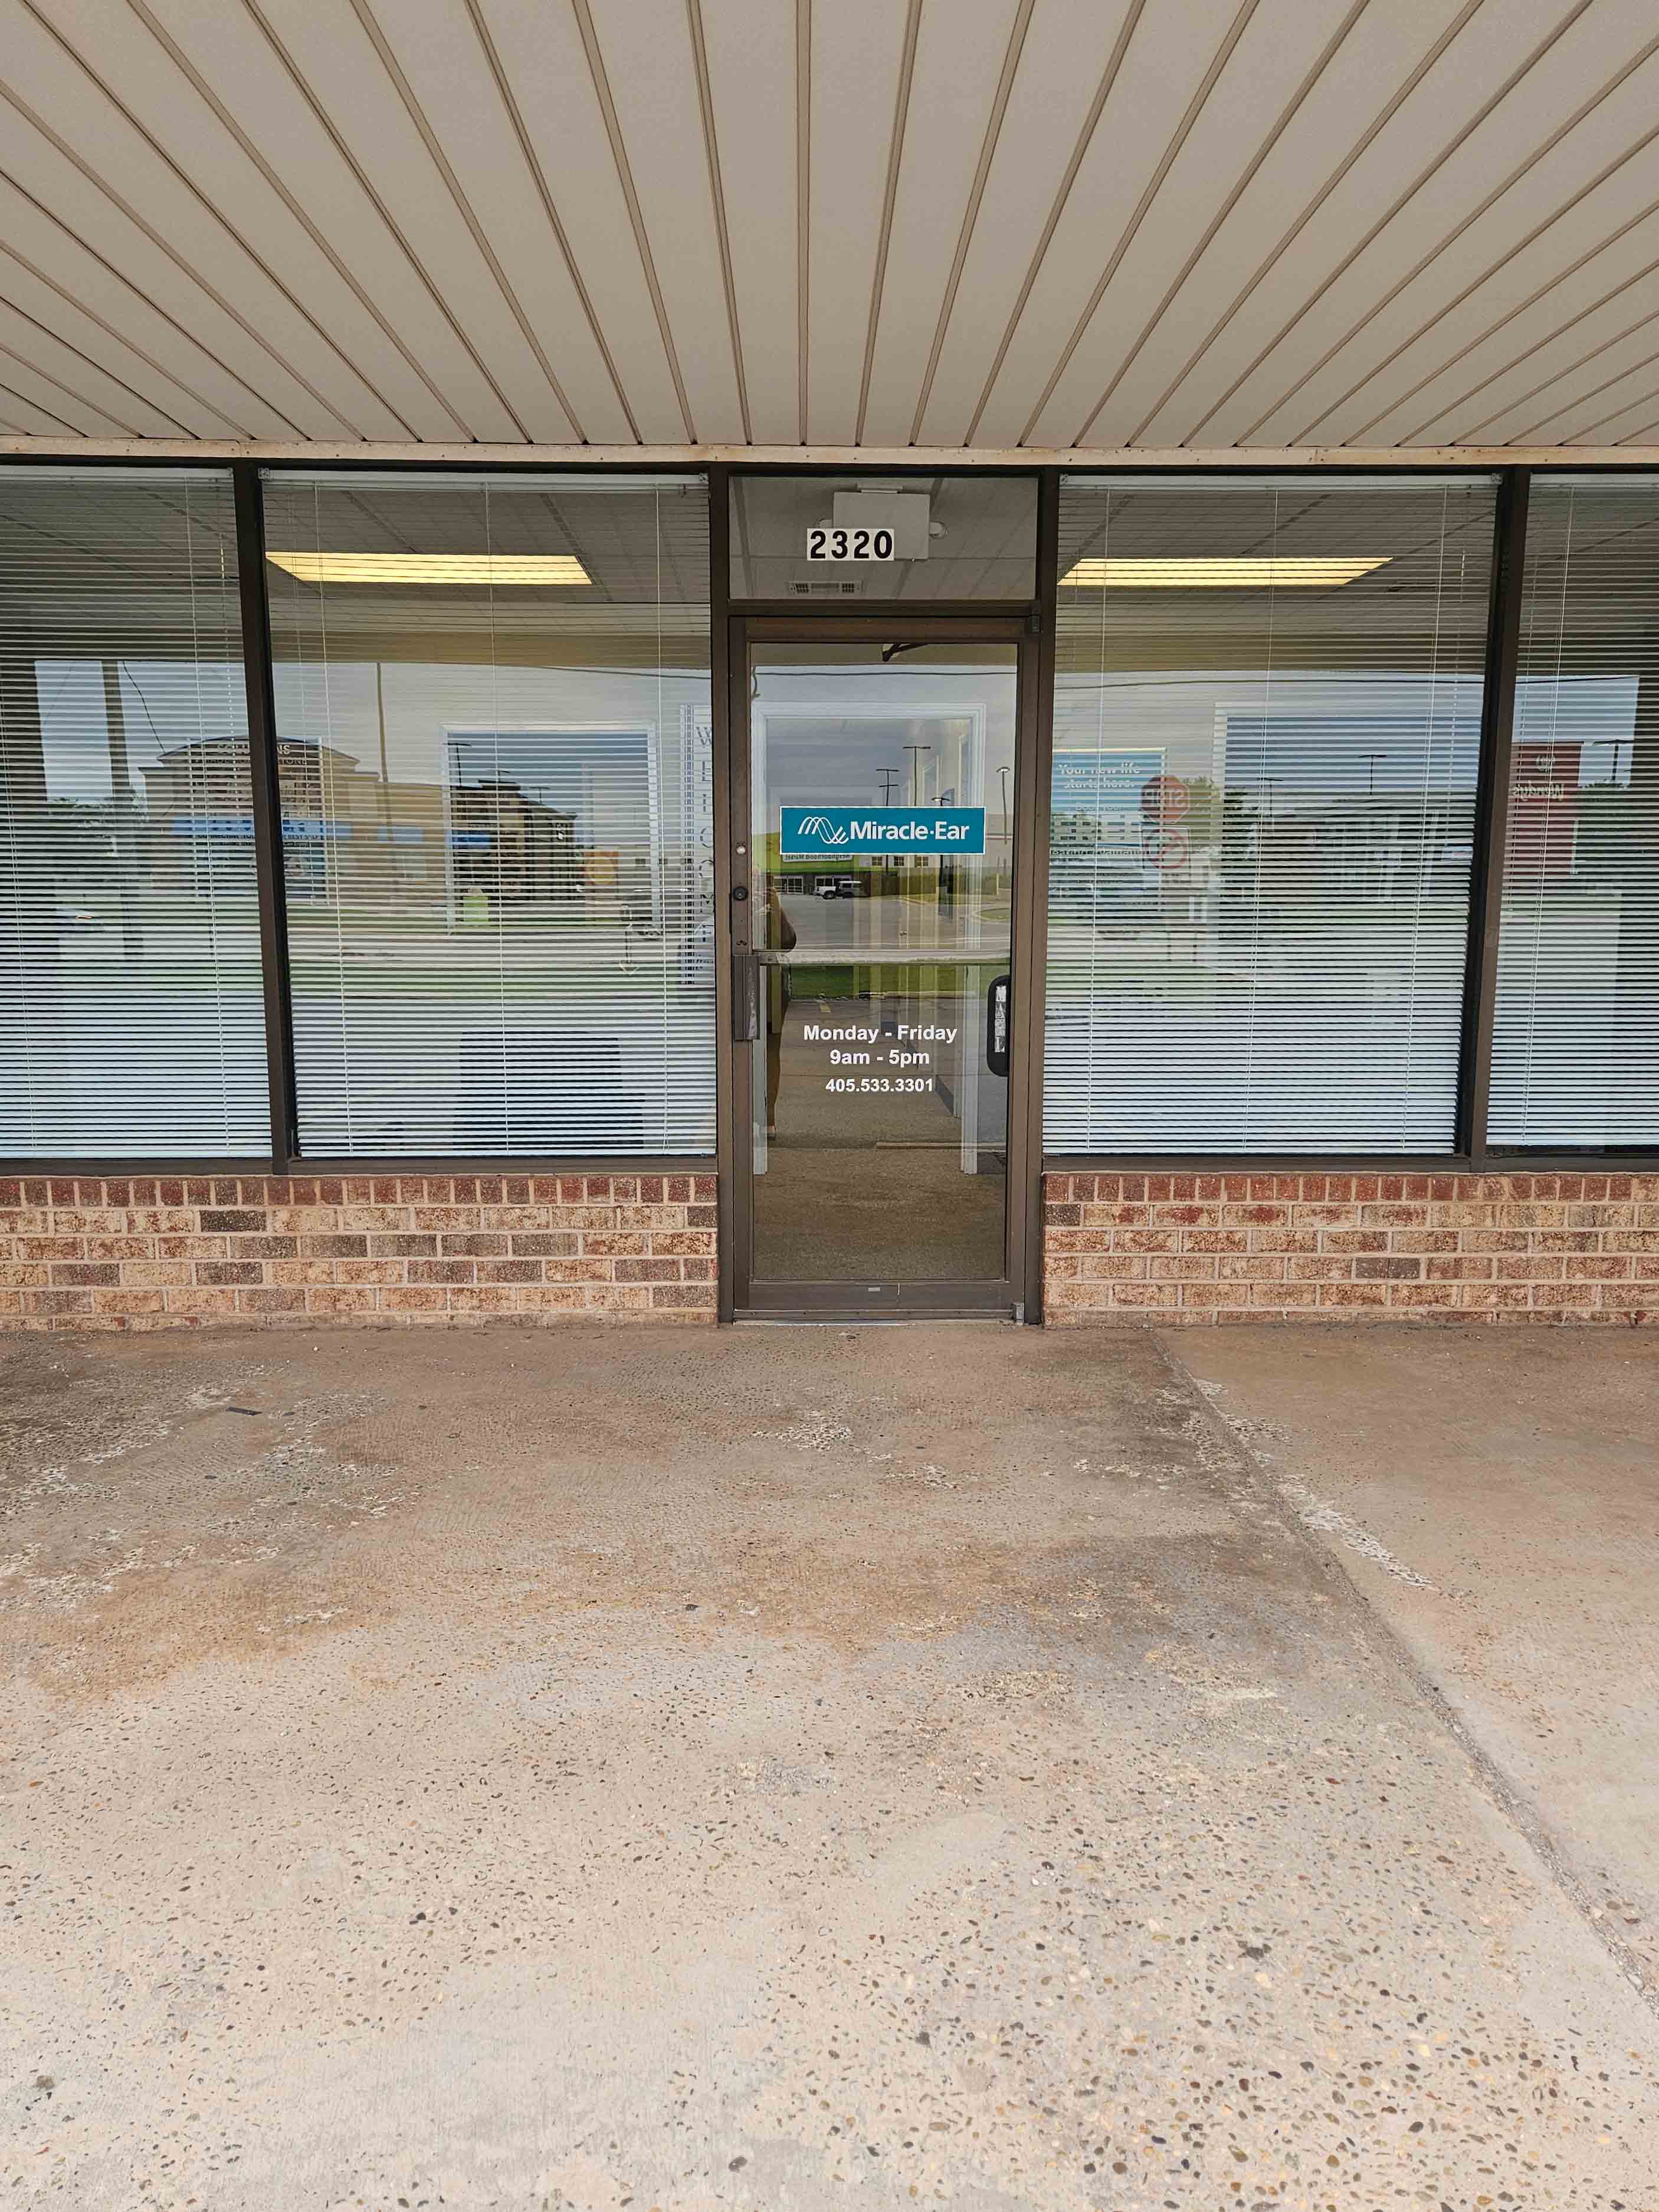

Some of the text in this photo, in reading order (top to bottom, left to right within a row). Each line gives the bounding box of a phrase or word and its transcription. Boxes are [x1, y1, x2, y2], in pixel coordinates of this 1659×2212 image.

[811, 530, 892, 559] 2320
[804, 1025, 879, 1043] Monday
[897, 1025, 958, 1043] Friday
[830, 1049, 870, 1064] 9am
[888, 1049, 930, 1068] 5pm
[825, 1079, 933, 1092] 405.533.3301
